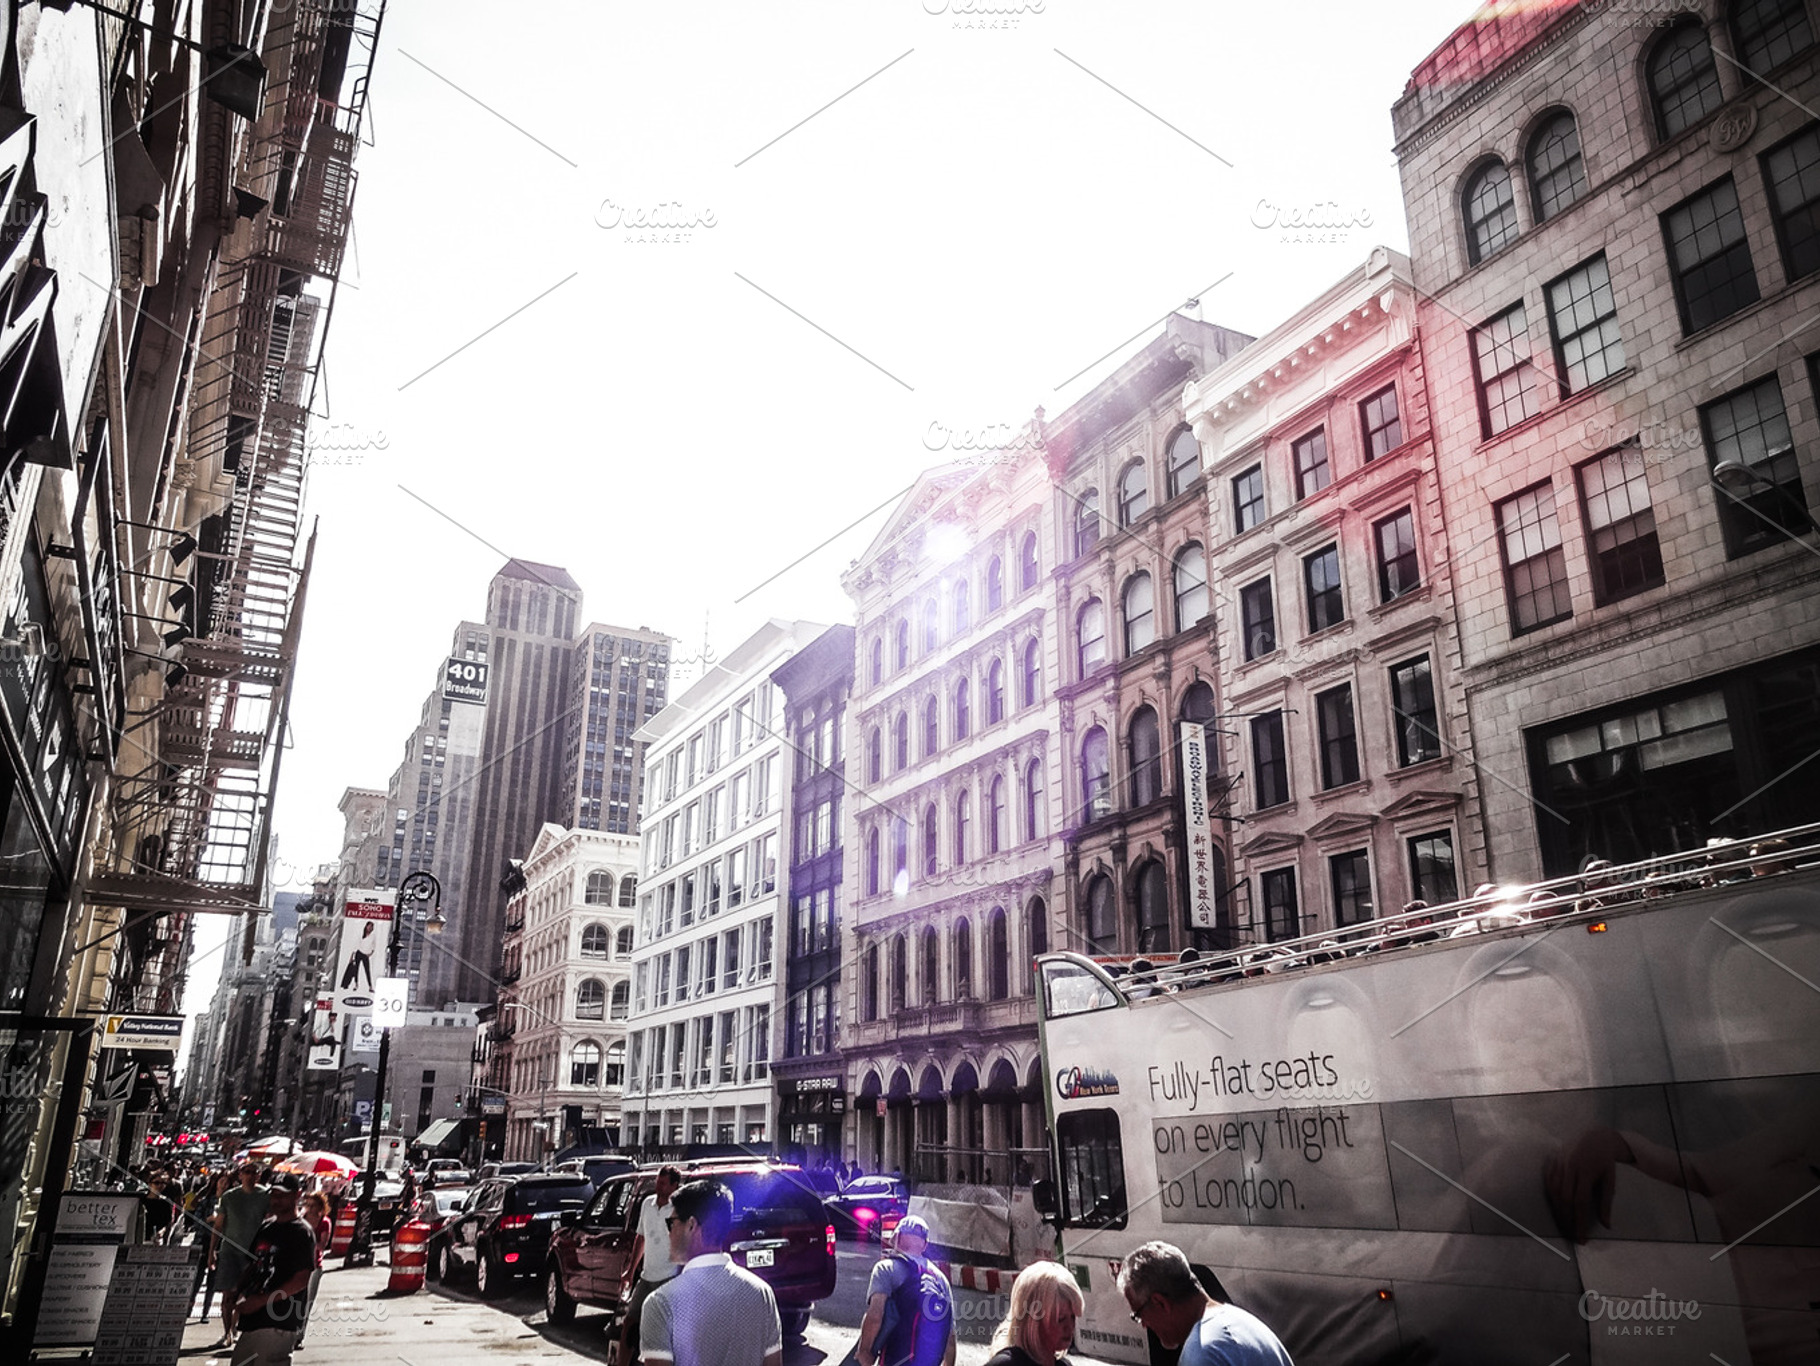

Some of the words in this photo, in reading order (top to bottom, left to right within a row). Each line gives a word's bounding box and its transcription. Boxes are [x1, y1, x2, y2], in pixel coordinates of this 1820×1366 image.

[449, 663, 485, 682] 401
[446, 681, 487, 699] Broadway
[358, 904, 383, 912] SOHO
[379, 998, 402, 1012] 30
[123, 1021, 140, 1031] Valley
[143, 1037, 170, 1045] Banking
[796, 1079, 821, 1091] G-STAR
[821, 1077, 838, 1089] RAW
[1148, 1056, 1254, 1111] Fully-flat
[1261, 1051, 1338, 1092] seats
[1154, 1125, 1186, 1154] on
[1194, 1121, 1266, 1164] every
[1275, 1105, 1354, 1163] flight
[1158, 1174, 1184, 1208] to
[1193, 1167, 1305, 1210] London.
[67, 1201, 118, 1214] better
[92, 1214, 117, 1225] tex
